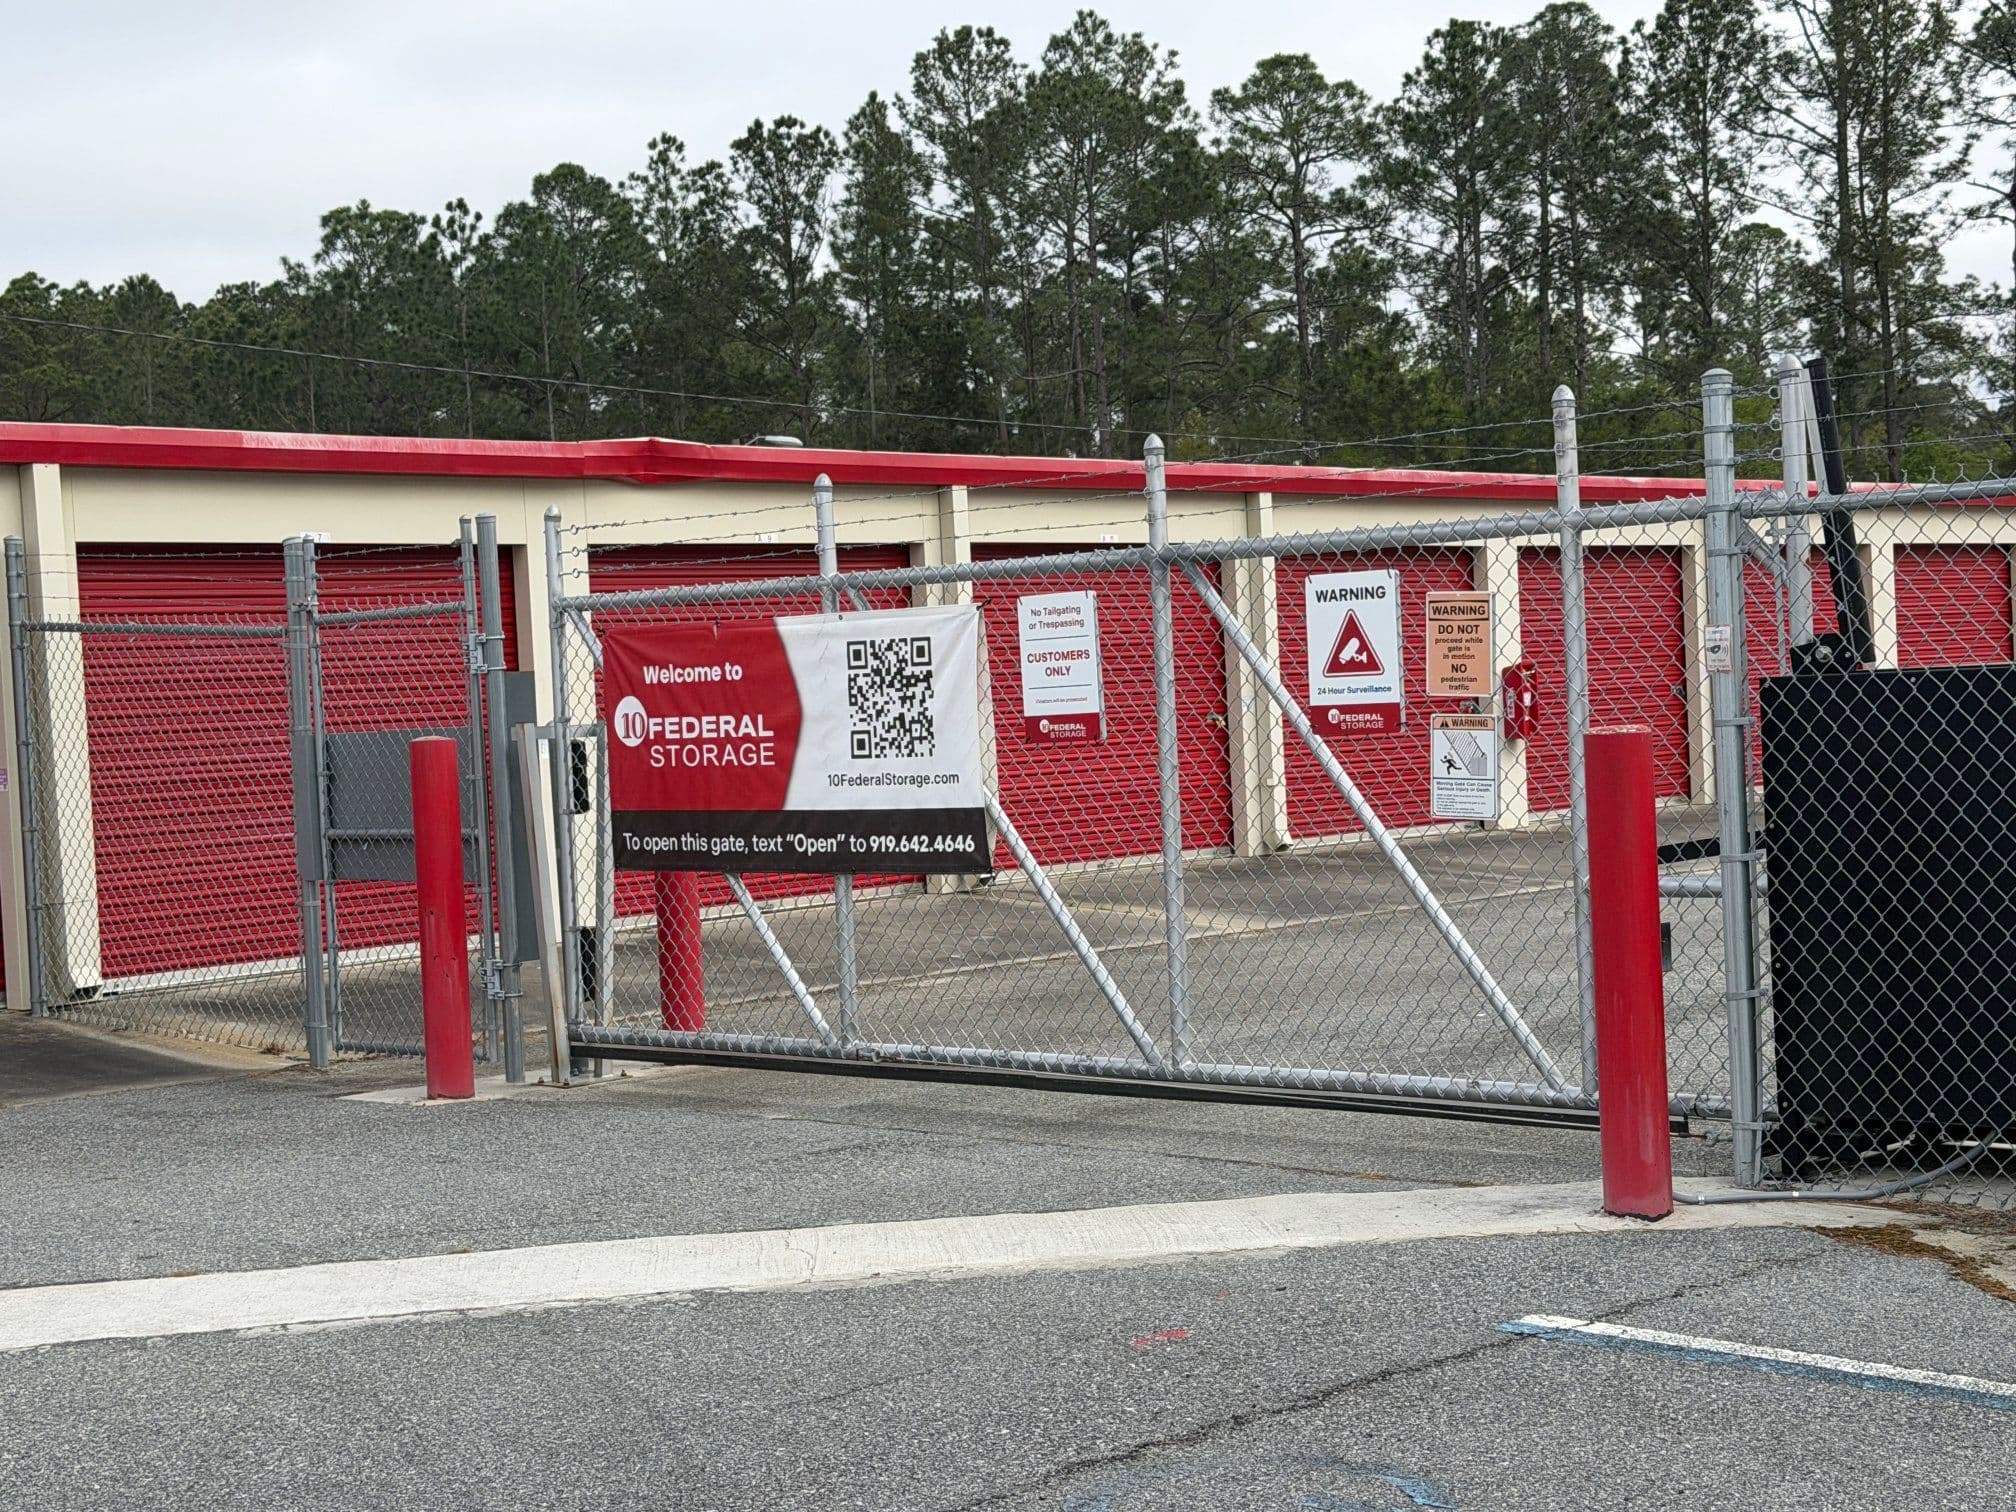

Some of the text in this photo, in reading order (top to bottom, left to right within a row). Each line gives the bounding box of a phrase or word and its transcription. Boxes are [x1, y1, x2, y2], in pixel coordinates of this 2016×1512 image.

[1315, 586, 1386, 603] WARNING
[1030, 606, 1081, 616] No Tailgating
[1432, 606, 1486, 616] WARNING
[1028, 618, 1085, 630] or Trespassing
[1438, 624, 1480, 634] DO NOT
[1434, 637, 1462, 645] proceed
[1027, 649, 1090, 664] CUSTOMERS
[642, 662, 743, 685] Welcome to
[1044, 666, 1072, 677] ONLY
[1451, 664, 1468, 674] NO
[1318, 684, 1392, 695] 24 Hour Surveillance
[1340, 713, 1384, 722] FEDERAL
[620, 712, 774, 740] 10 FEDERAL
[1049, 723, 1086, 732] FEDERAL
[1340, 721, 1384, 730] STORAGE
[1452, 718, 1488, 728] WARNING
[1050, 730, 1086, 739] STORAGE
[650, 743, 776, 768] STORAGE
[827, 771, 960, 788] 10FederalStorage.com
[623, 833, 642, 850] To
[643, 836, 678, 855] open
[680, 833, 708, 851] this
[711, 836, 750, 857] gate,
[752, 835, 783, 853] text
[850, 835, 867, 852] to
[869, 834, 975, 854] 919.642.4646
